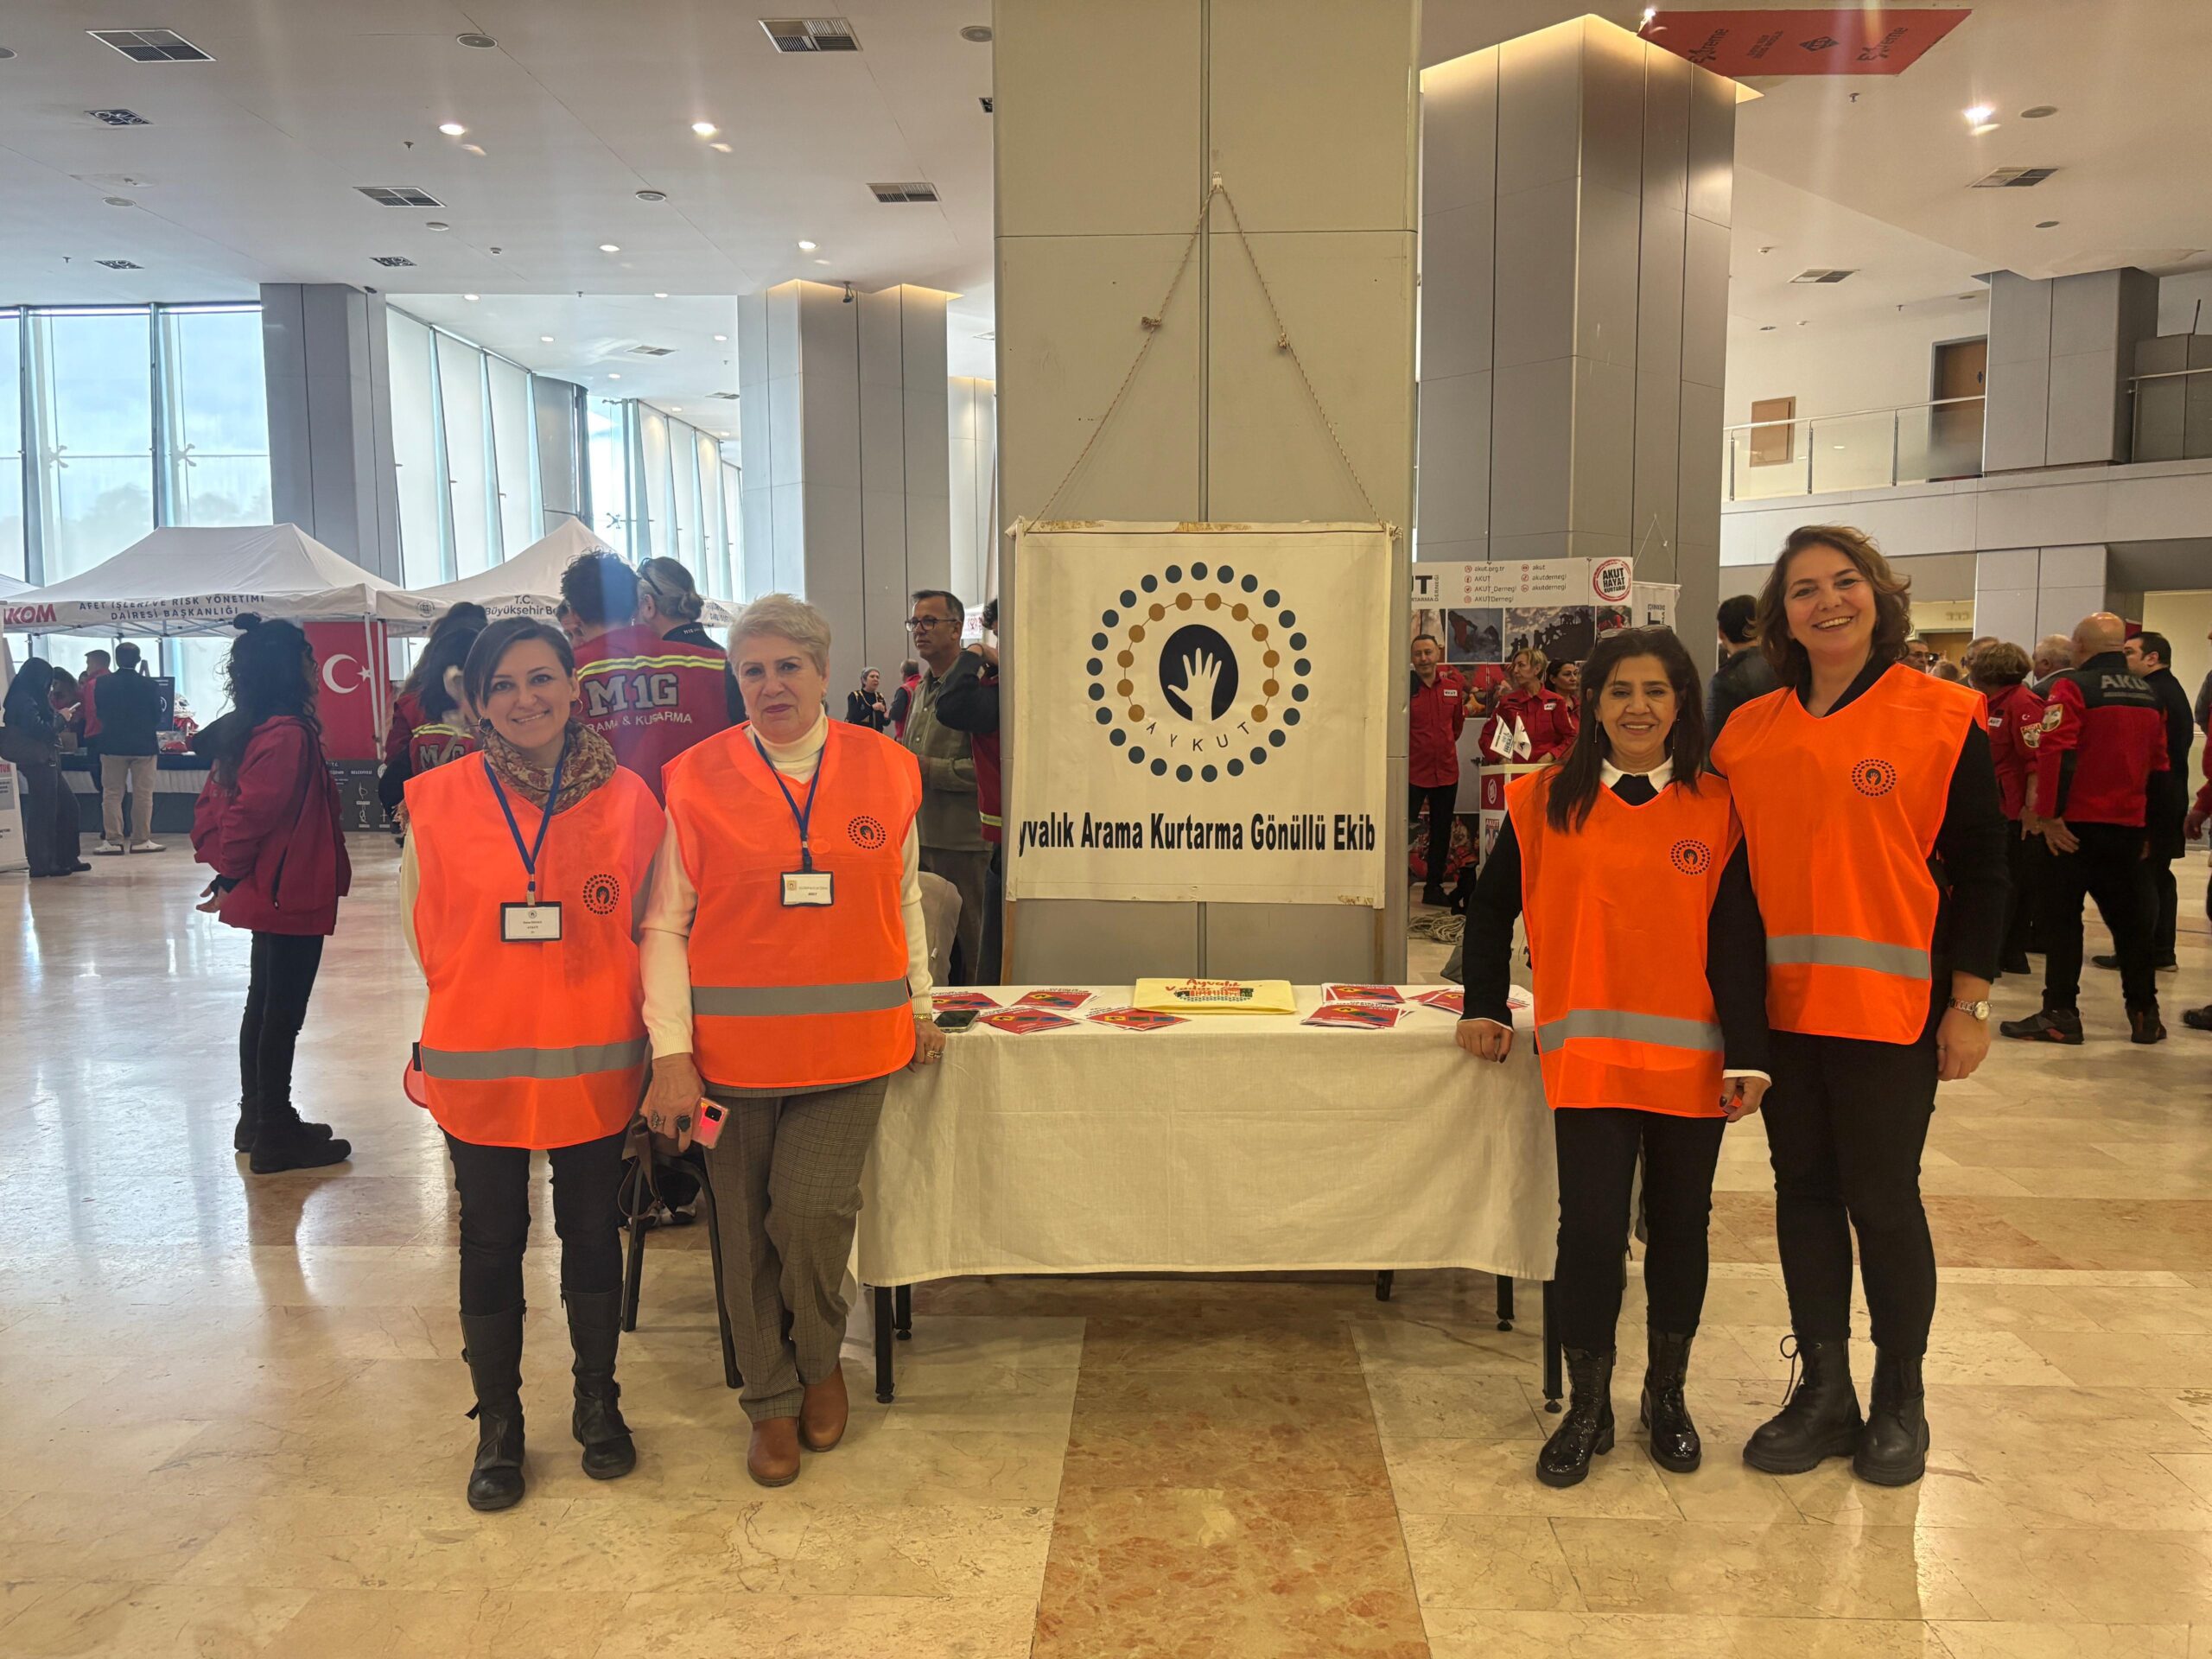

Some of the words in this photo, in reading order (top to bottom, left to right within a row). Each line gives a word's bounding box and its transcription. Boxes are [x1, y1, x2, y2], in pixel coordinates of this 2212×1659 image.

[1603, 568, 1624, 580] AKUT
[1603, 577, 1624, 588] HAYAT
[79, 601, 106, 610] AFET
[514, 594, 534, 605] T.C.
[584, 672, 680, 718] M1G
[1146, 721, 1249, 753] AYKUT
[1081, 811, 1144, 849] Arama
[1150, 812, 1243, 850] Kurtarma
[1251, 812, 1326, 851] Gönüllü
[1333, 814, 1376, 851] Ekib
